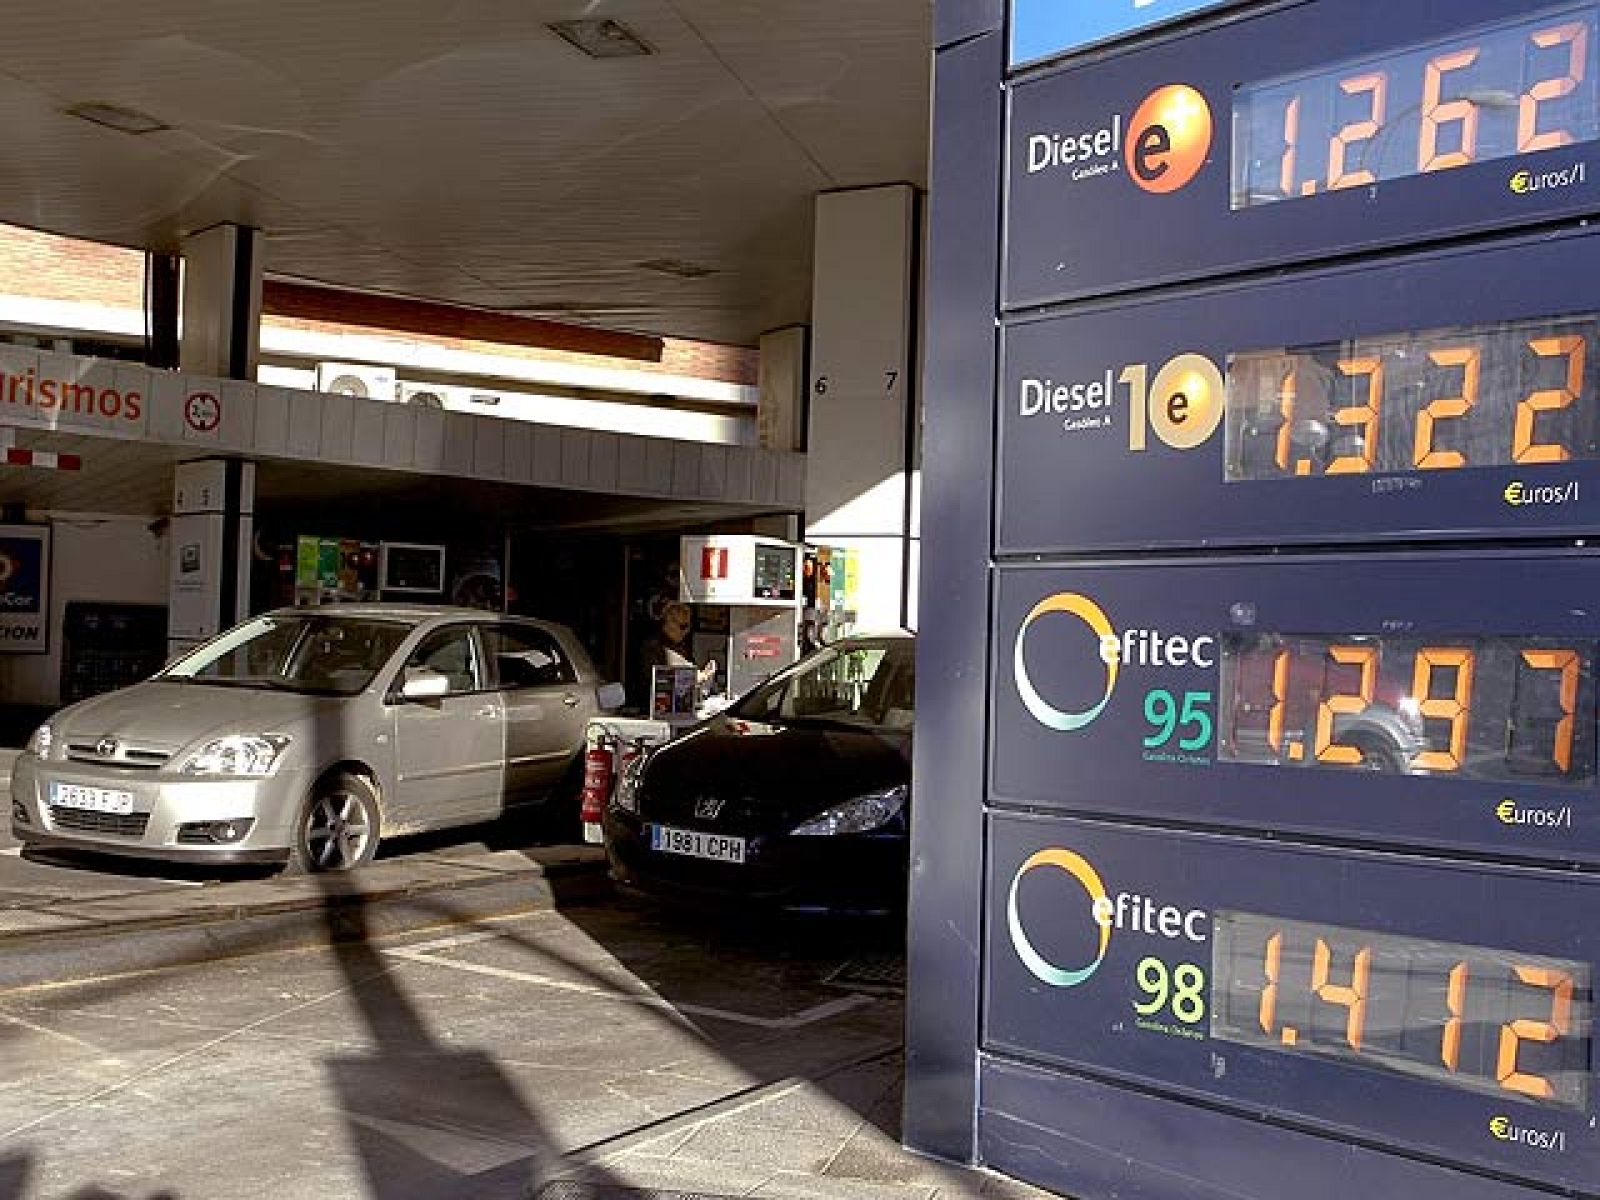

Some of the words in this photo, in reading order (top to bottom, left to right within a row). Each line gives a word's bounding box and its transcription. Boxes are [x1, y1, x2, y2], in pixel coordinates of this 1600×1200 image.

[1280, 22, 1589, 196] 1.262
[1029, 114, 1121, 173] Diesel
[1134, 124, 1171, 181] e
[814, 376, 827, 396] 6
[884, 369, 898, 391] 7
[1020, 369, 1113, 415] Diesel
[1275, 334, 1586, 475] 1.322
[1166, 392, 1188, 425] e
[1100, 628, 1214, 668] efitec
[1143, 689, 1212, 751] 95
[1270, 645, 1581, 773] 1.297
[707, 836, 742, 861] CPH
[1092, 892, 1206, 941] efitec
[1133, 957, 1206, 1024] 98
[1259, 930, 1574, 1099] 1.412
